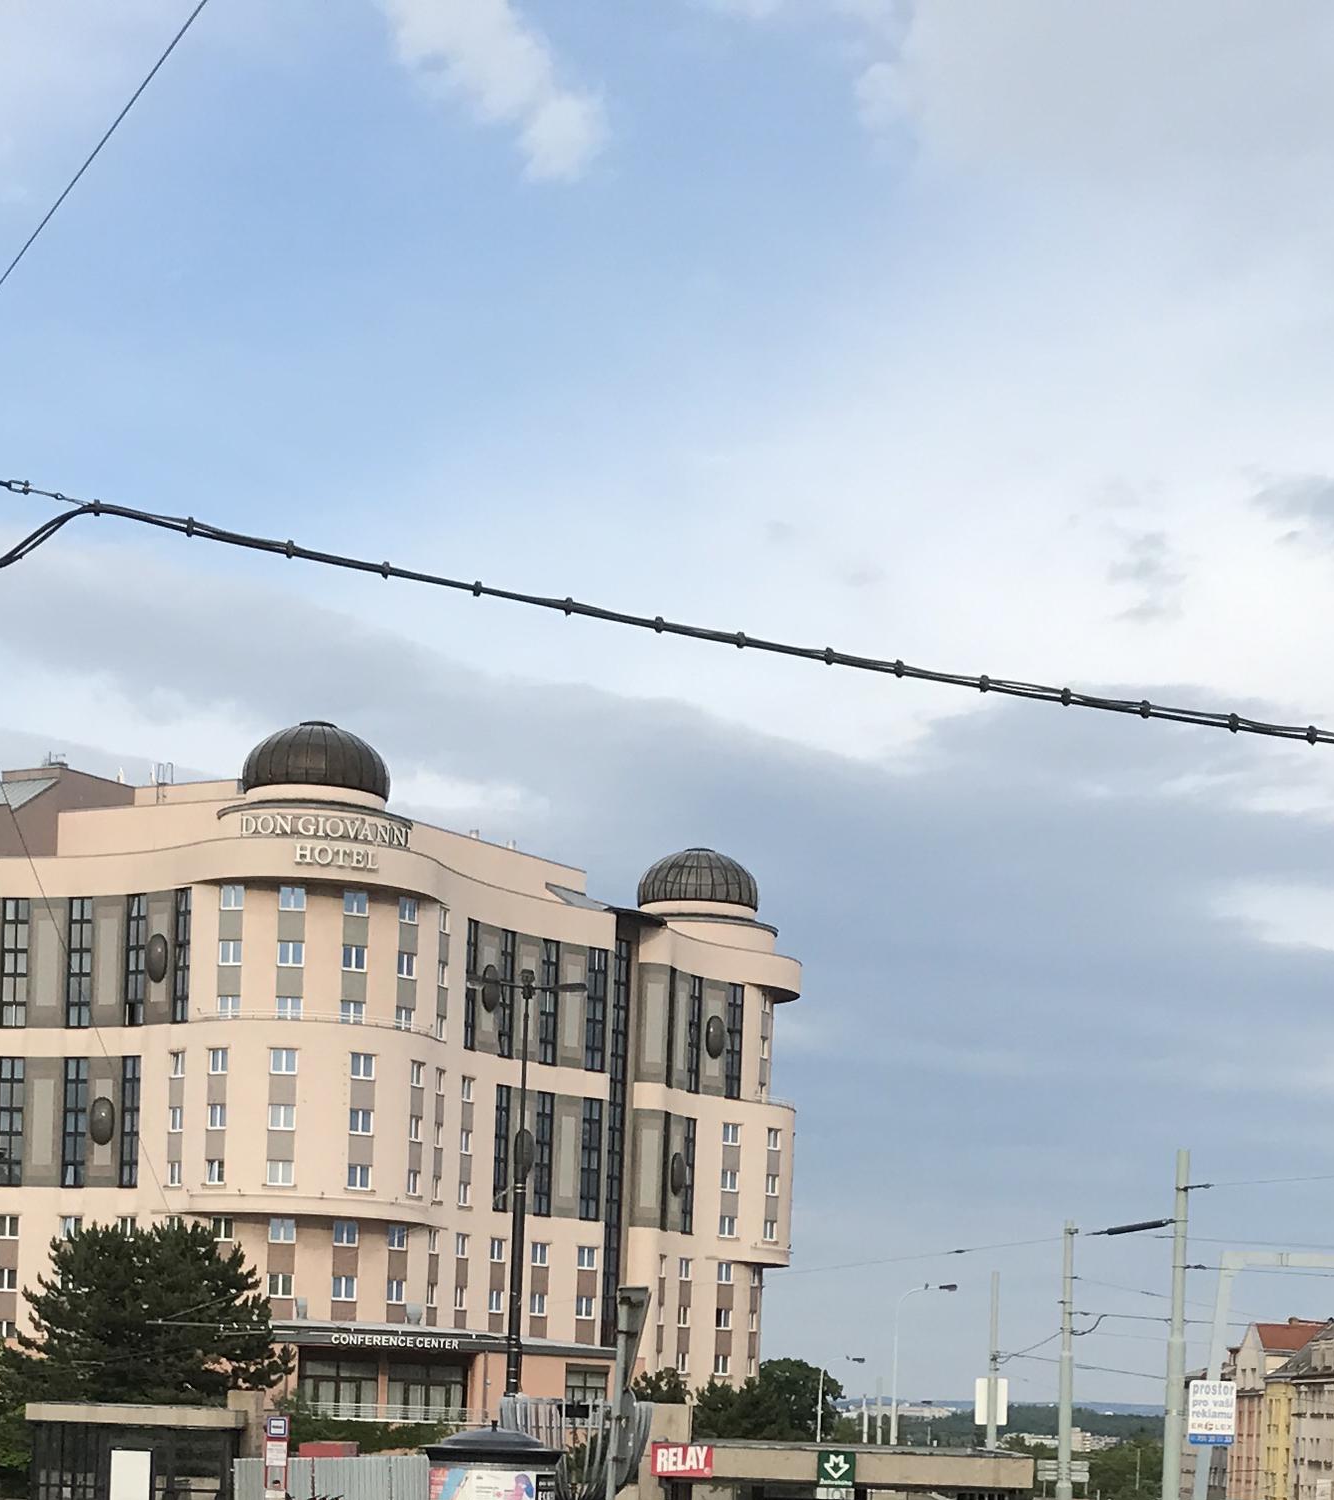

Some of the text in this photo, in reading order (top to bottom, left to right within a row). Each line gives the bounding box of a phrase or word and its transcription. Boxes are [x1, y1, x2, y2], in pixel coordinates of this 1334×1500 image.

[241, 815, 412, 849] DON GIOVANNI
[293, 843, 380, 870] HOTEL
[331, 1334, 459, 1349] CONFERENCE CENTER
[1193, 1382, 1234, 1397] prostor
[1193, 1400, 1208, 1408] pro
[1192, 1409, 1233, 1419] reklamu
[657, 1446, 707, 1472] RELAY
